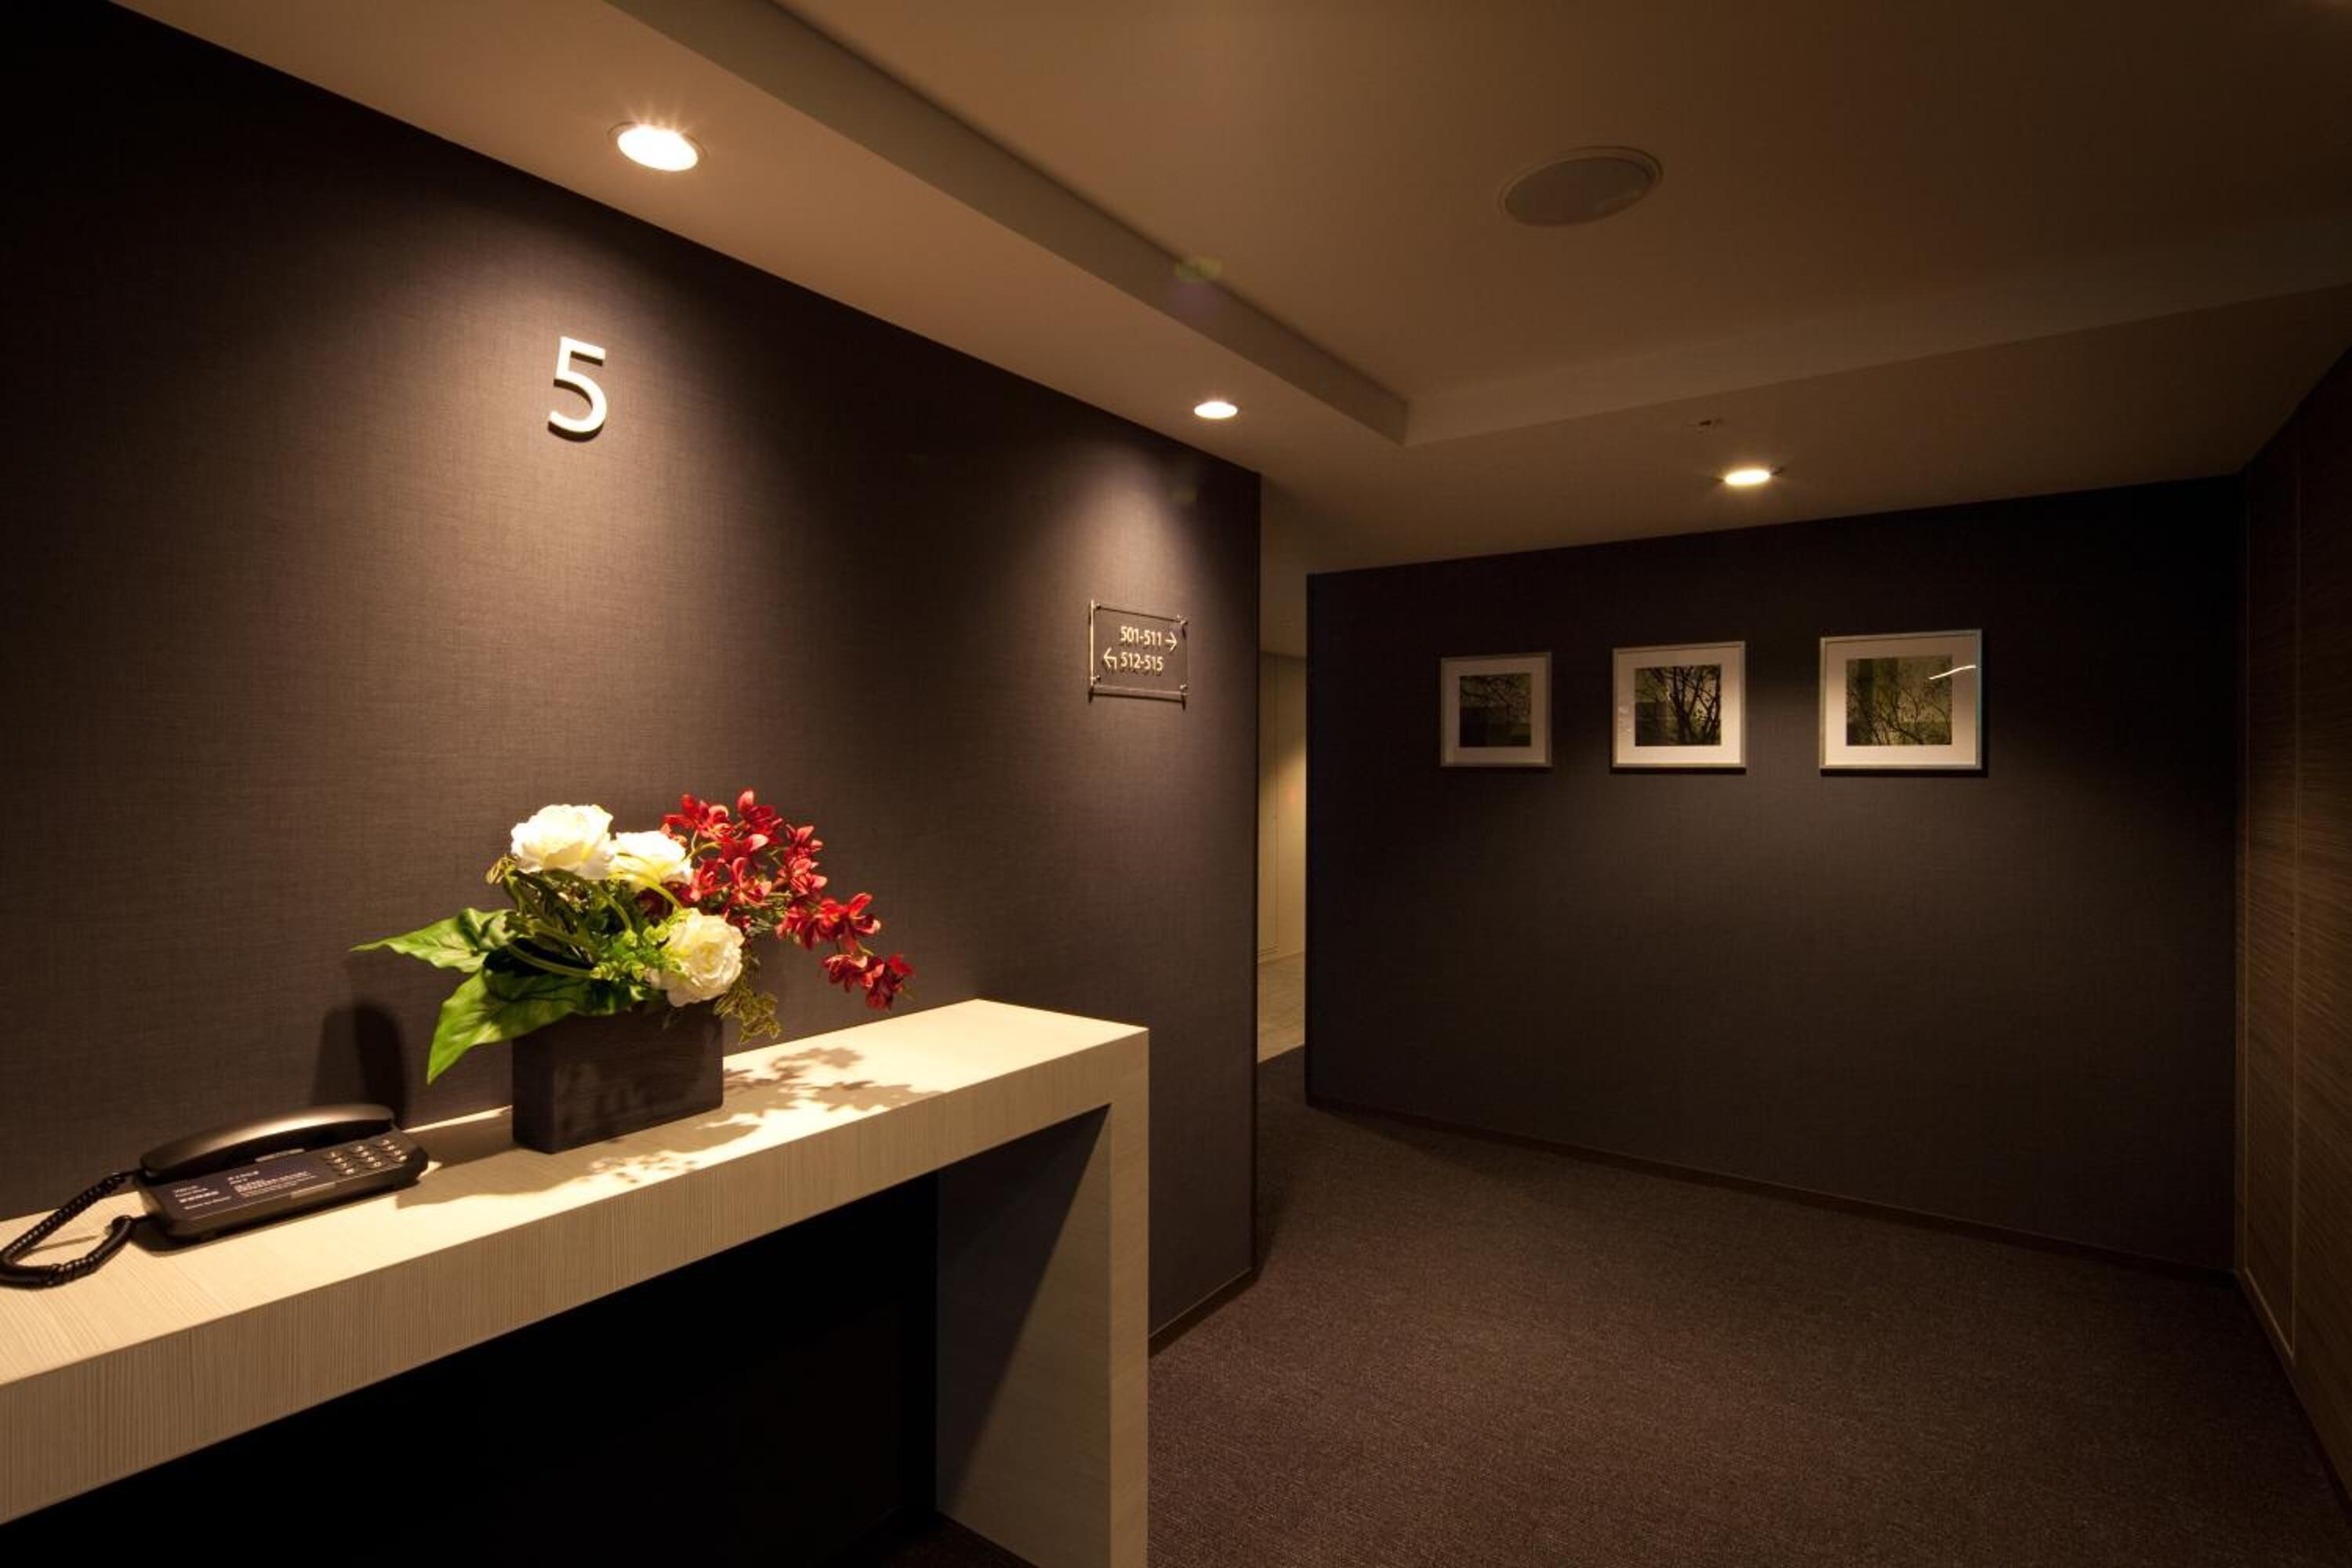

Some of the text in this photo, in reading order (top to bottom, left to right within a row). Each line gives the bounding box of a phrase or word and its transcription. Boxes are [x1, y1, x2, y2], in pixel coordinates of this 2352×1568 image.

[550, 336, 608, 433] 5
[1120, 626, 1162, 646] 501-511
[1120, 652, 1163, 672] 512-515
